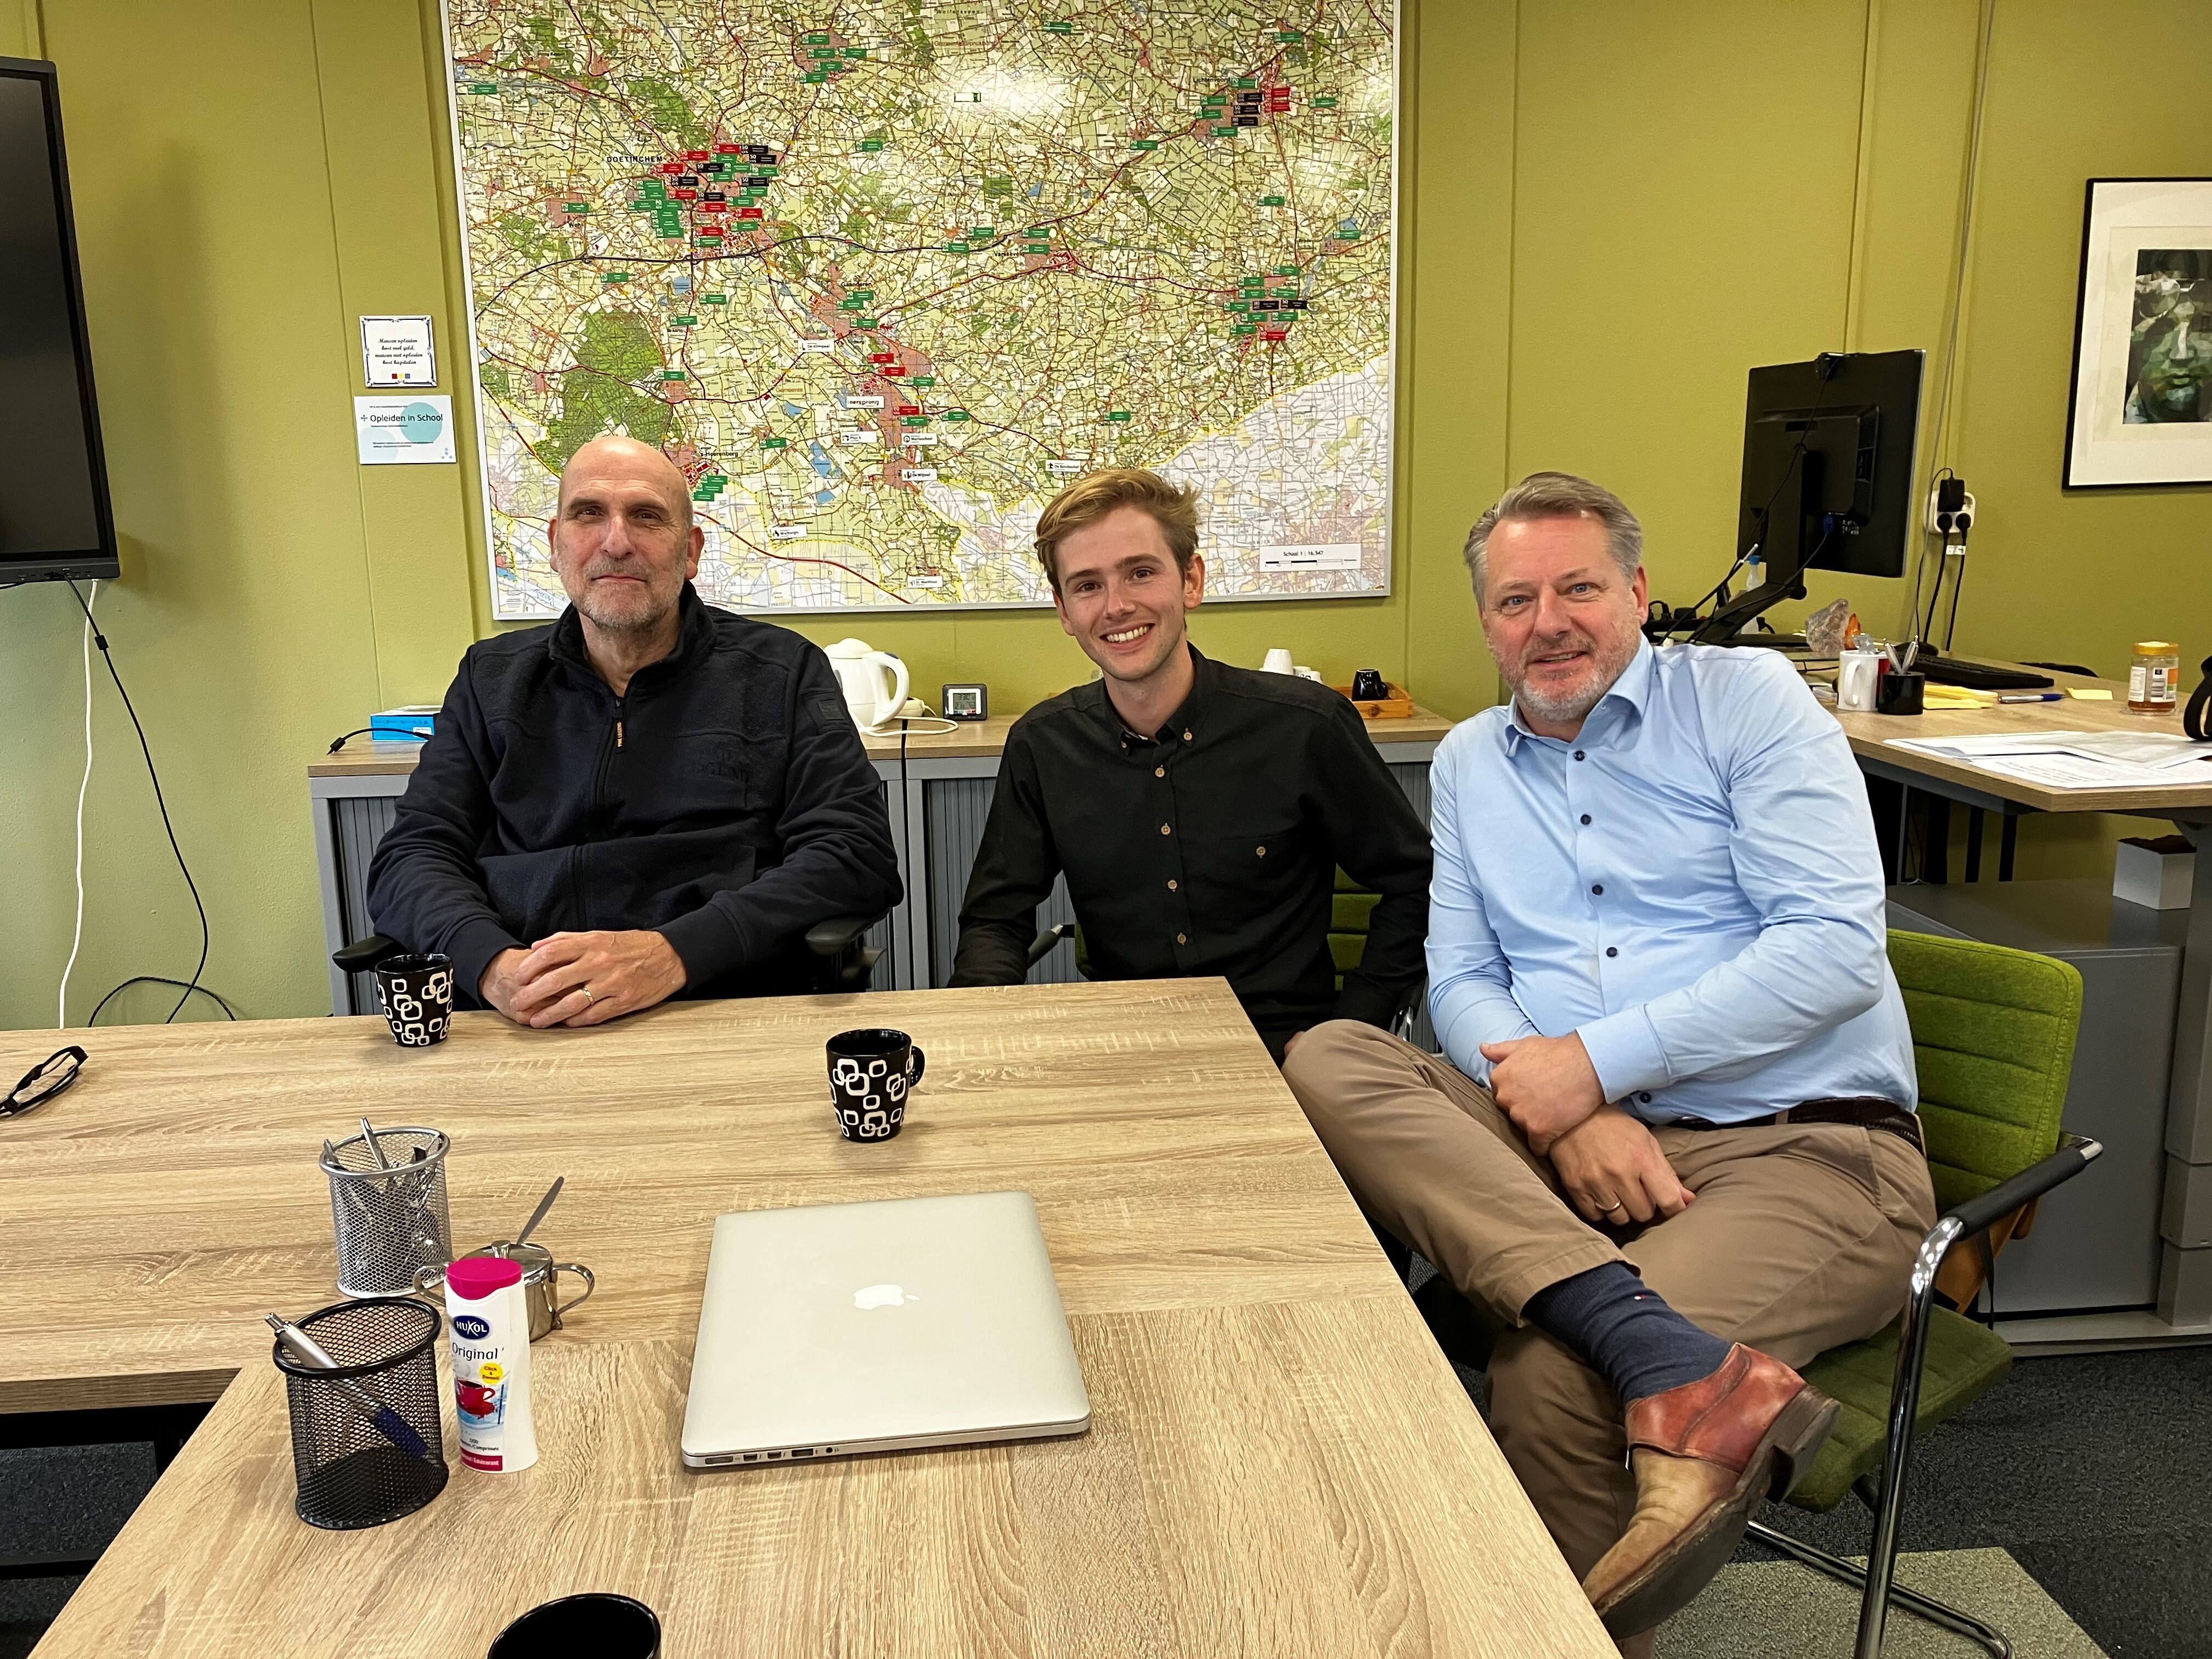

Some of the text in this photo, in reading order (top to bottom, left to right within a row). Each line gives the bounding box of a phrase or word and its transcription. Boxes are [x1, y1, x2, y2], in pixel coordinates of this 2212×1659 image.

[370, 414, 405, 423] Opleiden
[456, 1321, 487, 1336] HUXOL
[452, 1342, 498, 1361] Original
